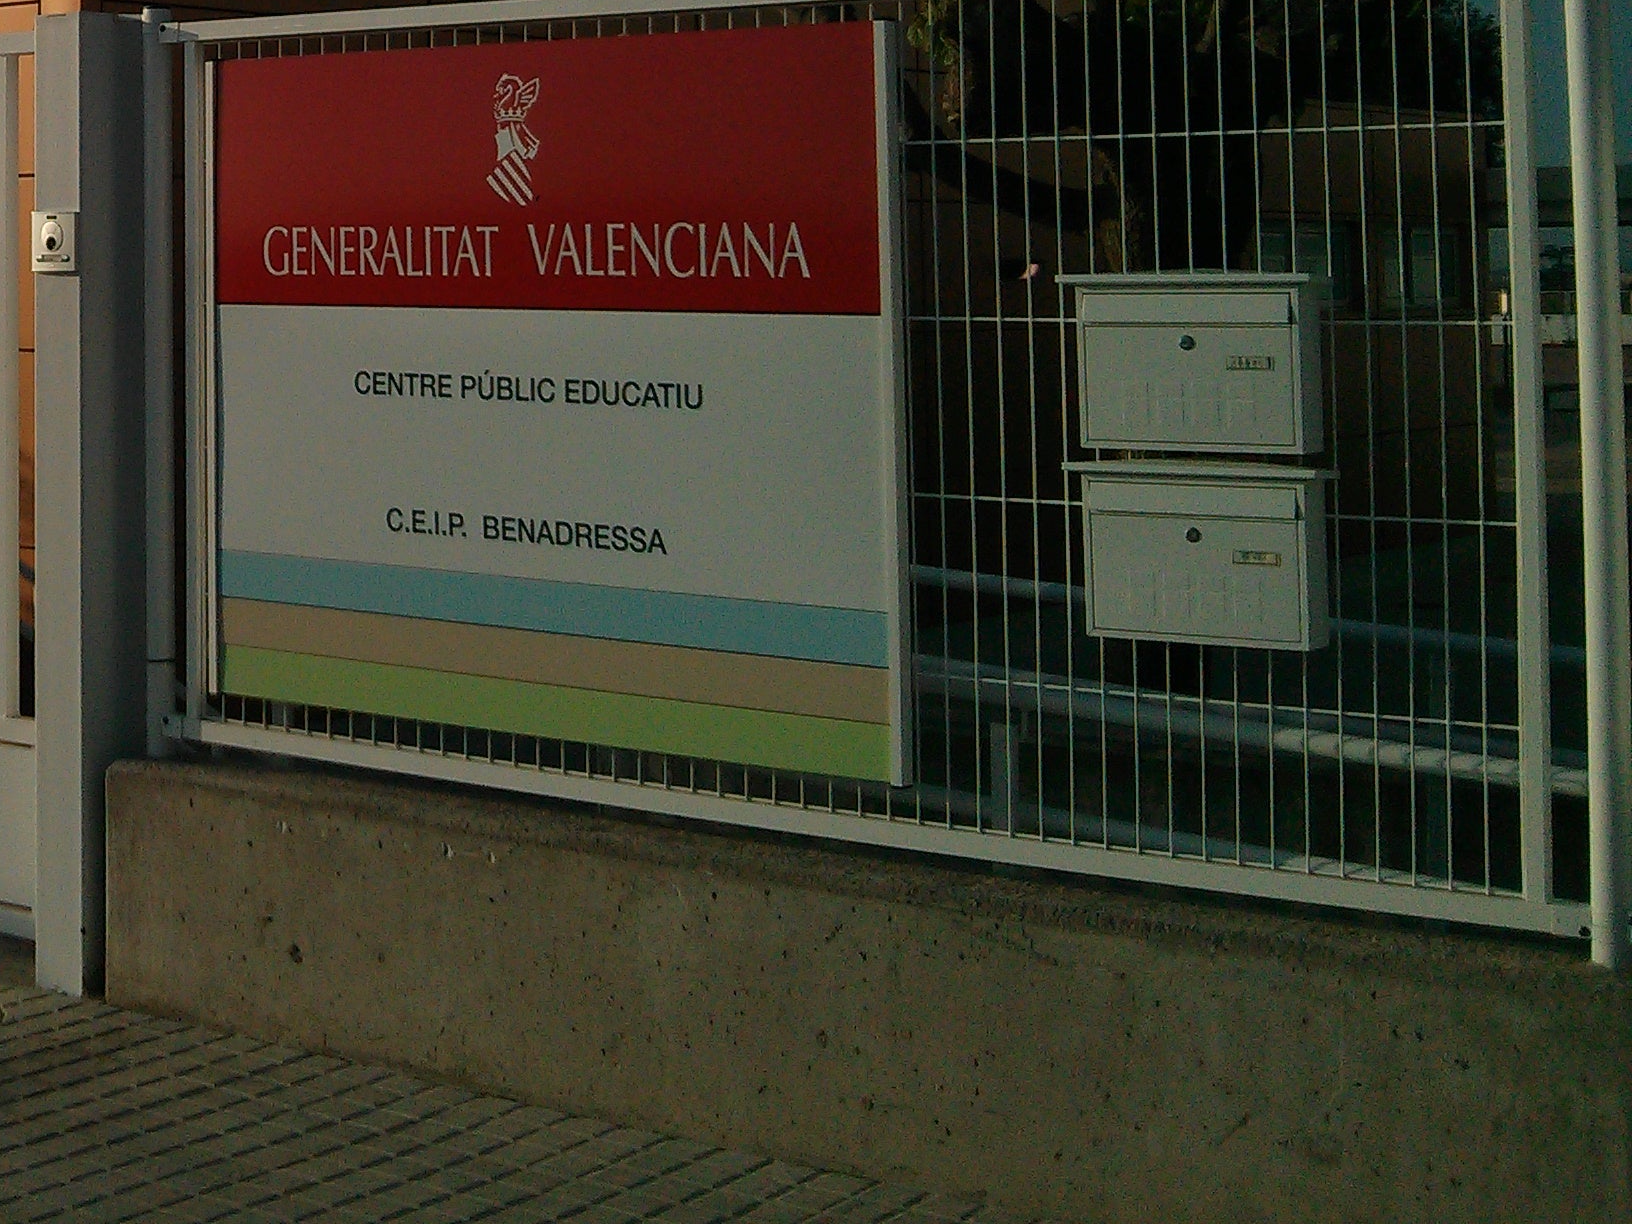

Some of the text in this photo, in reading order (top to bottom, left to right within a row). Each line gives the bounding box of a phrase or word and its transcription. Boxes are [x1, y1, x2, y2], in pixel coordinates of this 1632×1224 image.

[263, 222, 811, 278] GENERALITAT VALENCIANA
[353, 369, 704, 410] CENTRE PÚBLIC EDUCATIU
[385, 508, 668, 555] C.E.I.P. BENADRESSA
